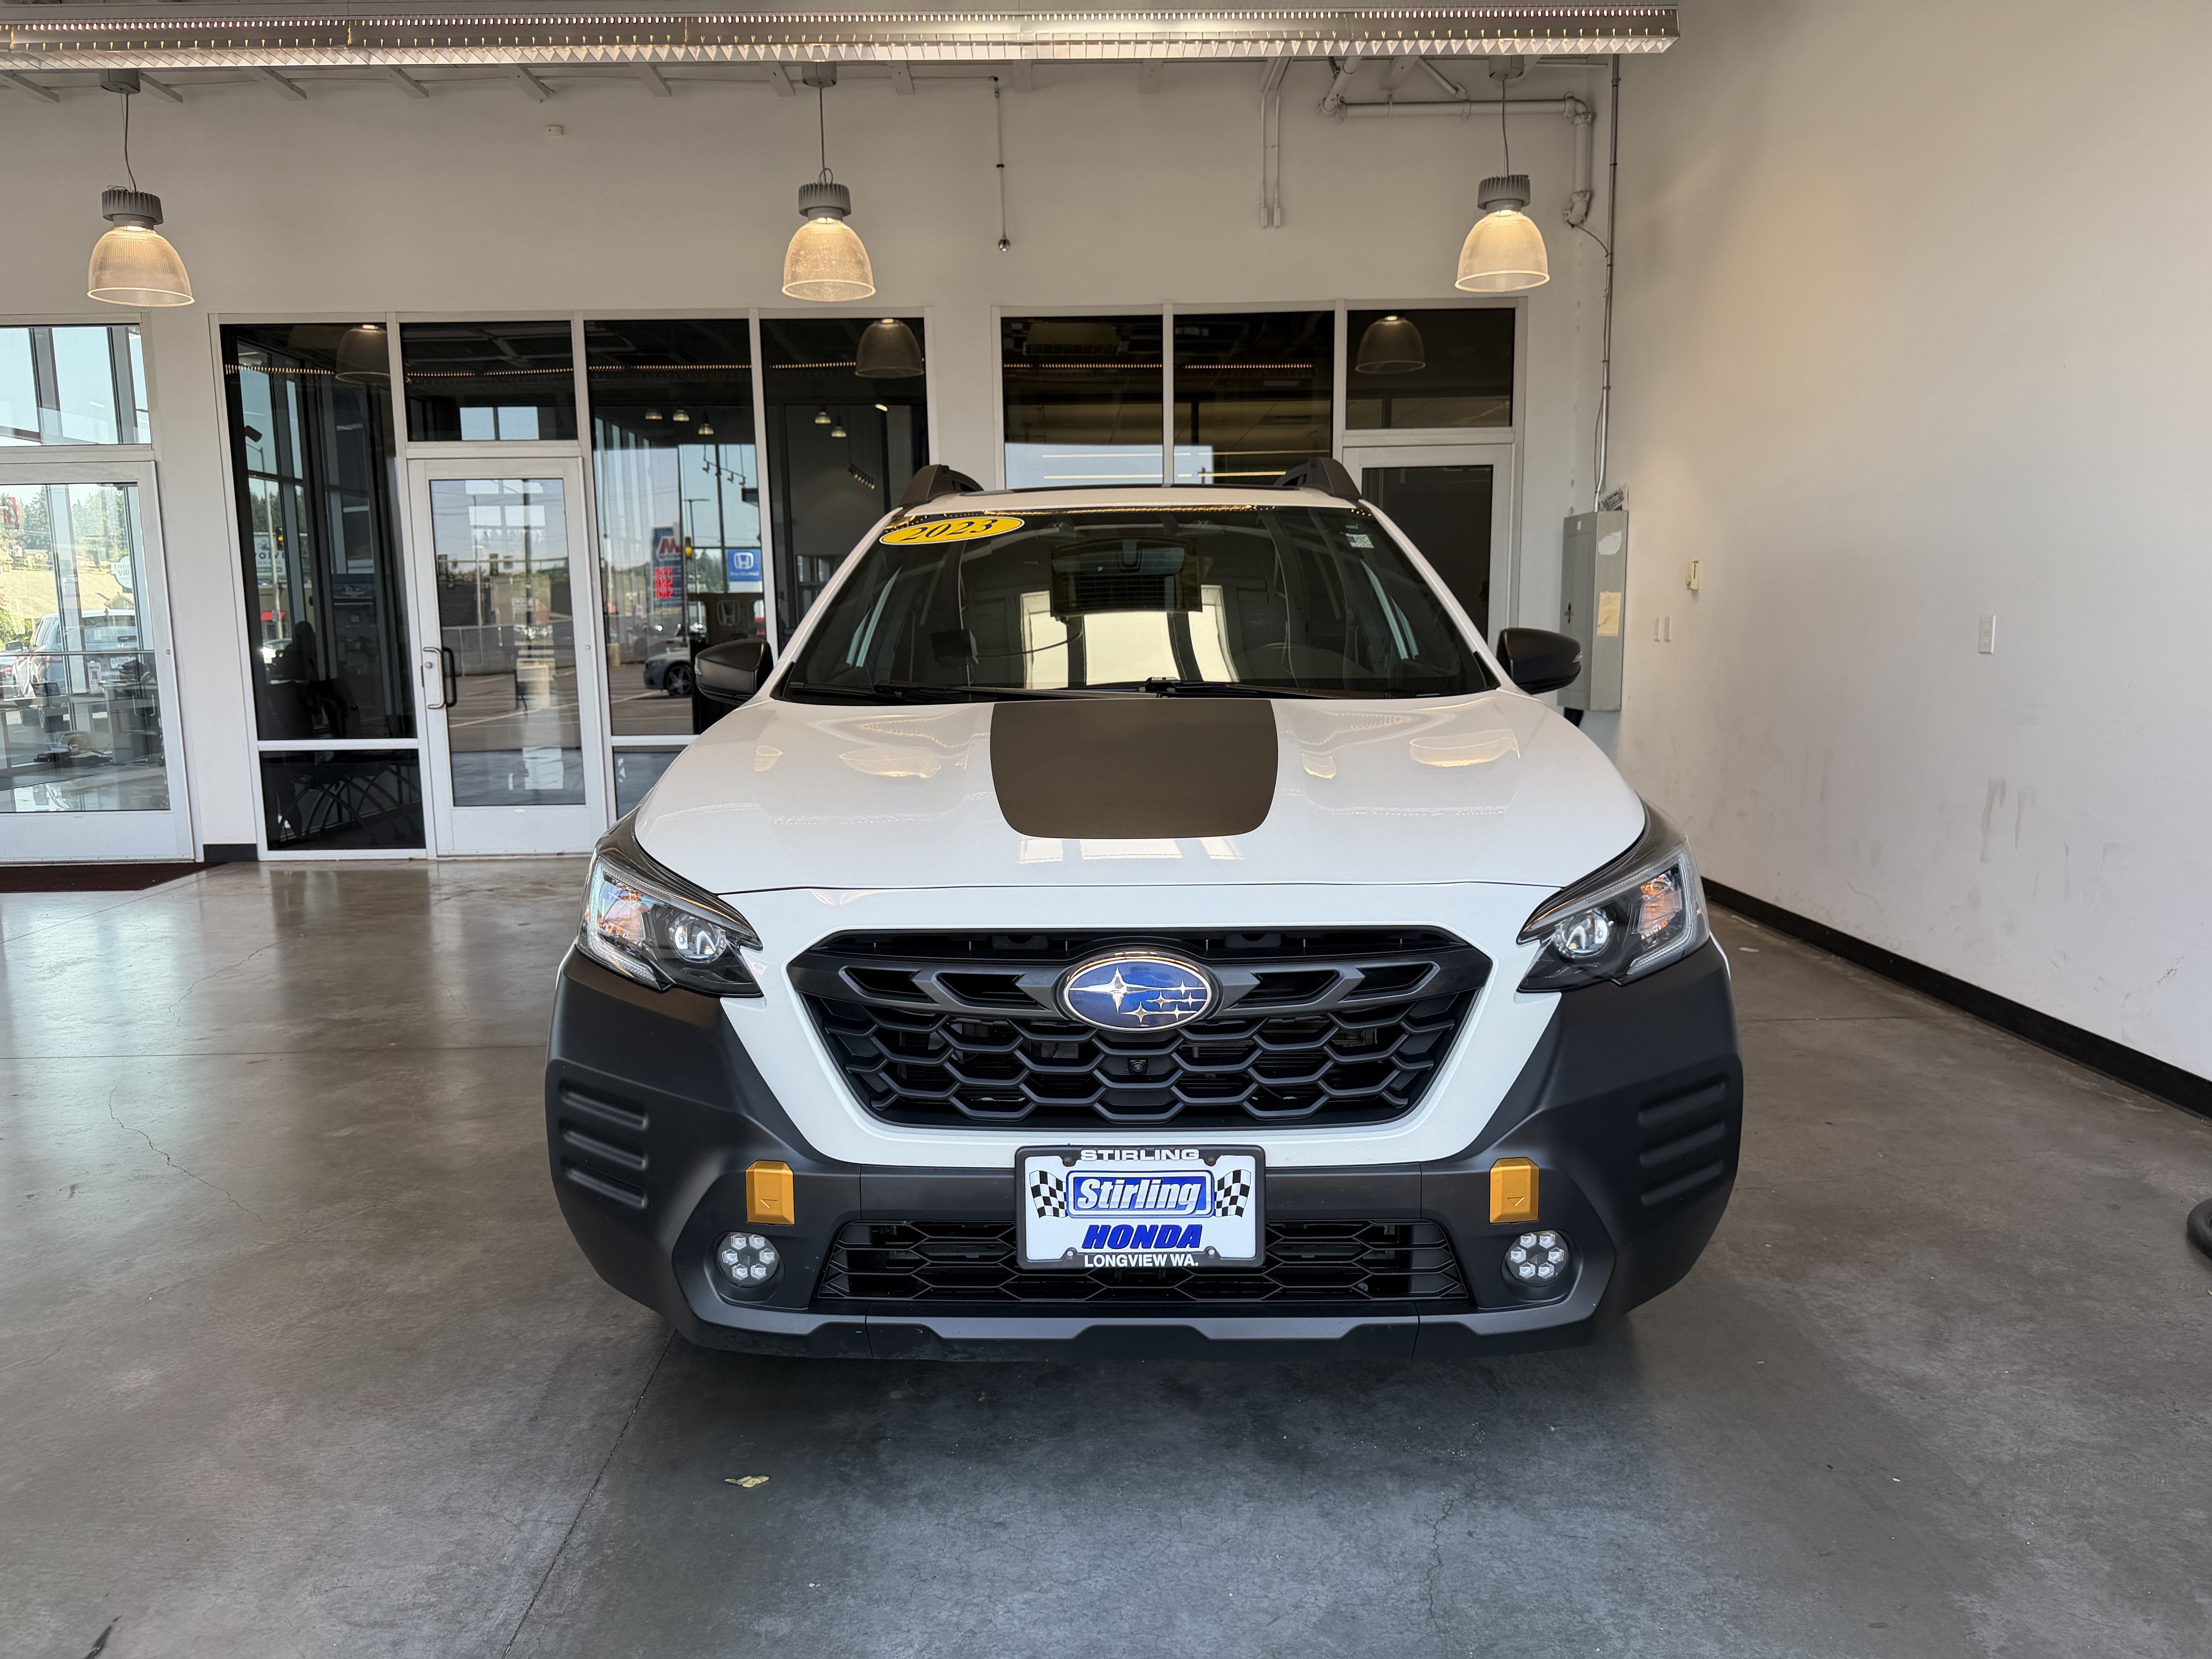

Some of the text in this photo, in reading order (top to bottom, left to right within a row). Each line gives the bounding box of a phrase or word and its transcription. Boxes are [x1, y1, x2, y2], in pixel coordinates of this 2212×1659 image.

[899, 519, 998, 541] 2023
[1080, 1149, 1200, 1161] STIRLING
[1077, 1178, 1201, 1215] Stirling
[1081, 1224, 1203, 1249] HONDA
[1084, 1254, 1199, 1267] LONGVIEW WA.
